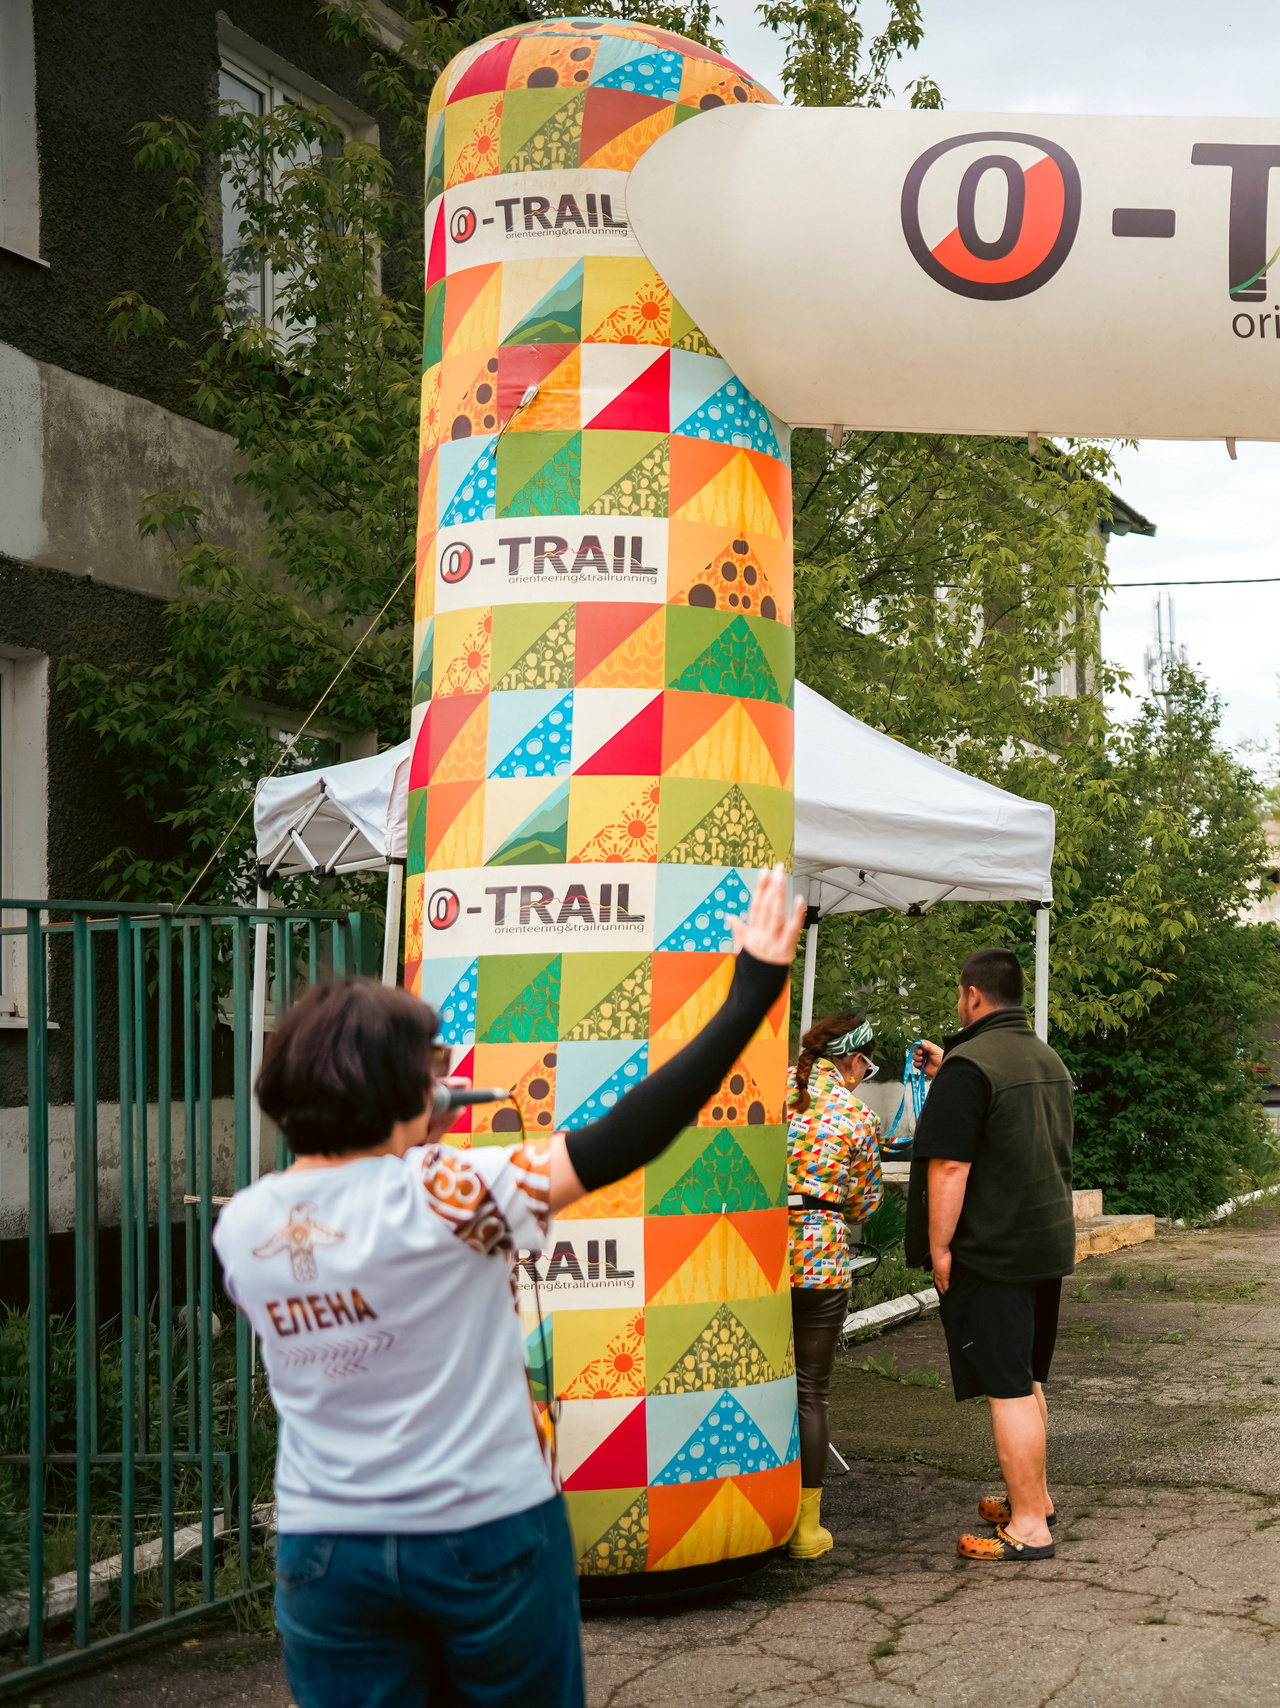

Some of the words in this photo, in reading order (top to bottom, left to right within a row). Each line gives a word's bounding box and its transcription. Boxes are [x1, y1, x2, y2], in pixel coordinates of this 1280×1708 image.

[506, 226, 628, 240] orienteering&trailrunning
[508, 573, 658, 585] orienteering&trailrunning
[494, 922, 645, 935] orienteering&trailrunning
[266, 1287, 379, 1337] ЕЛЕНА
